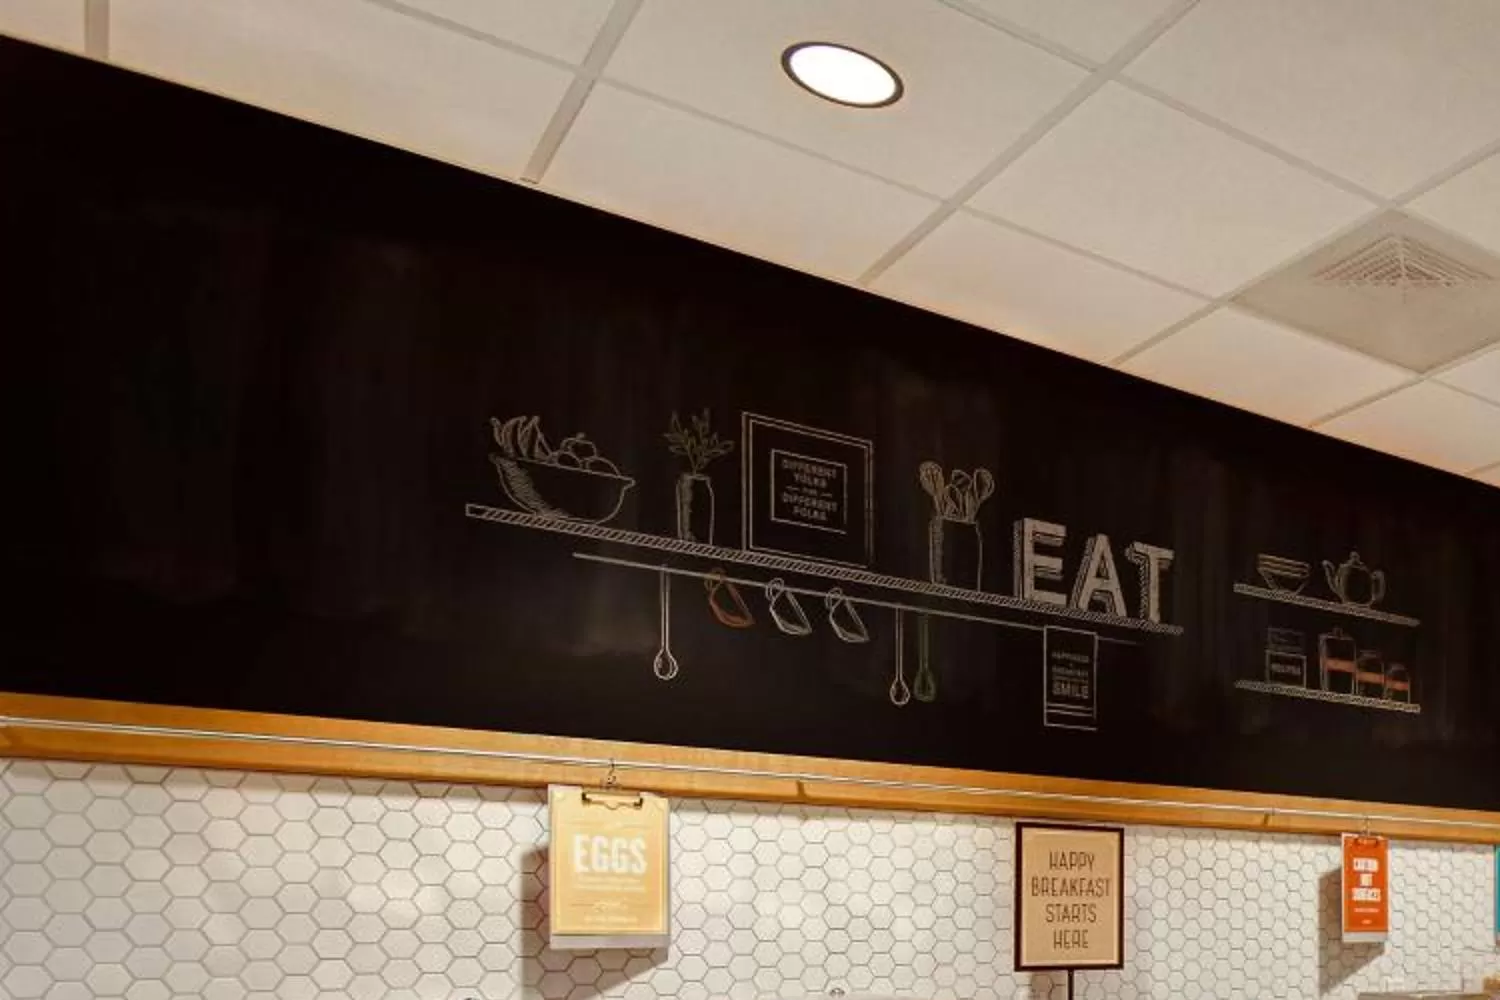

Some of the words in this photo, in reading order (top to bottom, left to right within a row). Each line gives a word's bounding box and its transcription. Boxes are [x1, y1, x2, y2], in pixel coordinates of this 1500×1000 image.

[783, 459, 836, 479] DIFFERENT
[783, 491, 837, 512] DIFFERENT
[1013, 517, 1175, 624] EAT
[1052, 680, 1088, 699] SMILE
[574, 833, 647, 875] EGGS
[1049, 851, 1095, 871] HAPPY
[1031, 876, 1111, 898] BREAKFAST
[1045, 903, 1097, 923] STARTS
[1053, 929, 1089, 949] HERE
